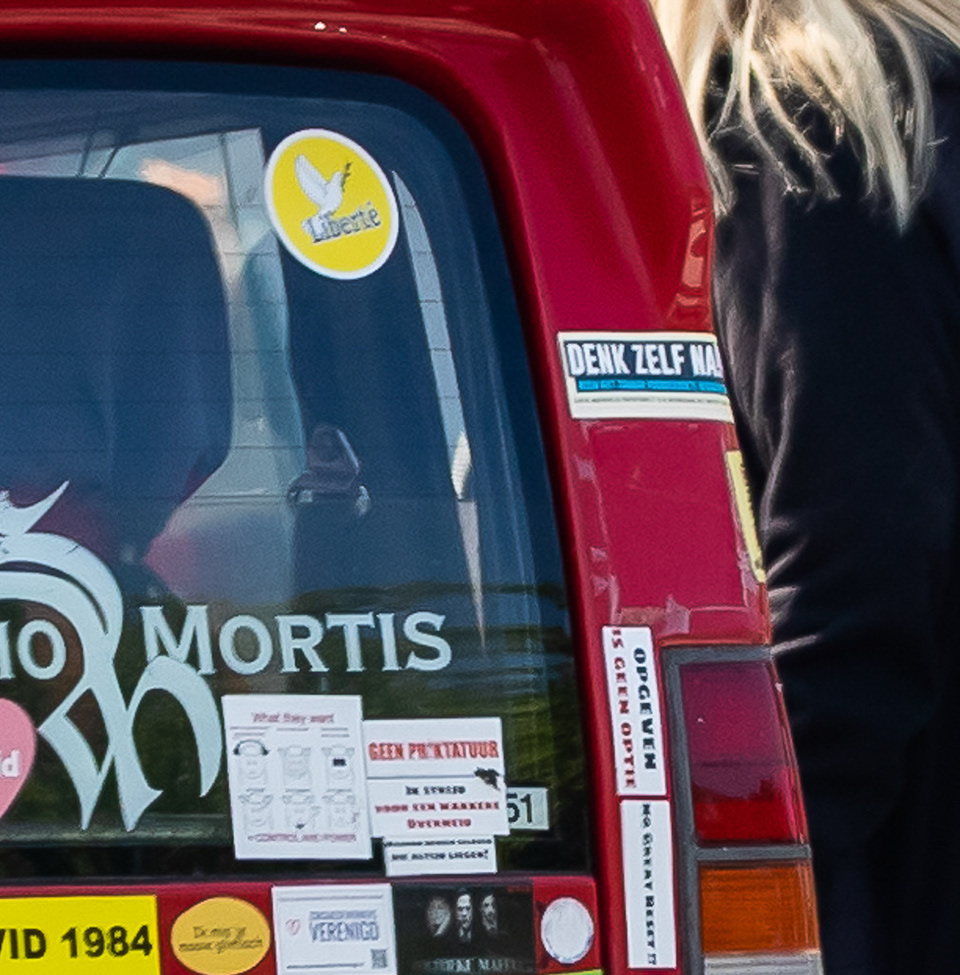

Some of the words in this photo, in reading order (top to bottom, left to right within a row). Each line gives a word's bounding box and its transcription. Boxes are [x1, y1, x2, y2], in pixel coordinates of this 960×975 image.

[308, 200, 381, 243] Liberté
[566, 343, 630, 376] DENK
[631, 343, 685, 376] ZELF
[139, 604, 453, 676] MORTIS
[613, 656, 630, 715] GEEN
[634, 646, 657, 771] OPGEVEN
[368, 742, 405, 761] GEEN
[620, 721, 637, 789] OPTIE
[60, 925, 153, 959] 1984
[310, 920, 380, 942] VERENIGD
